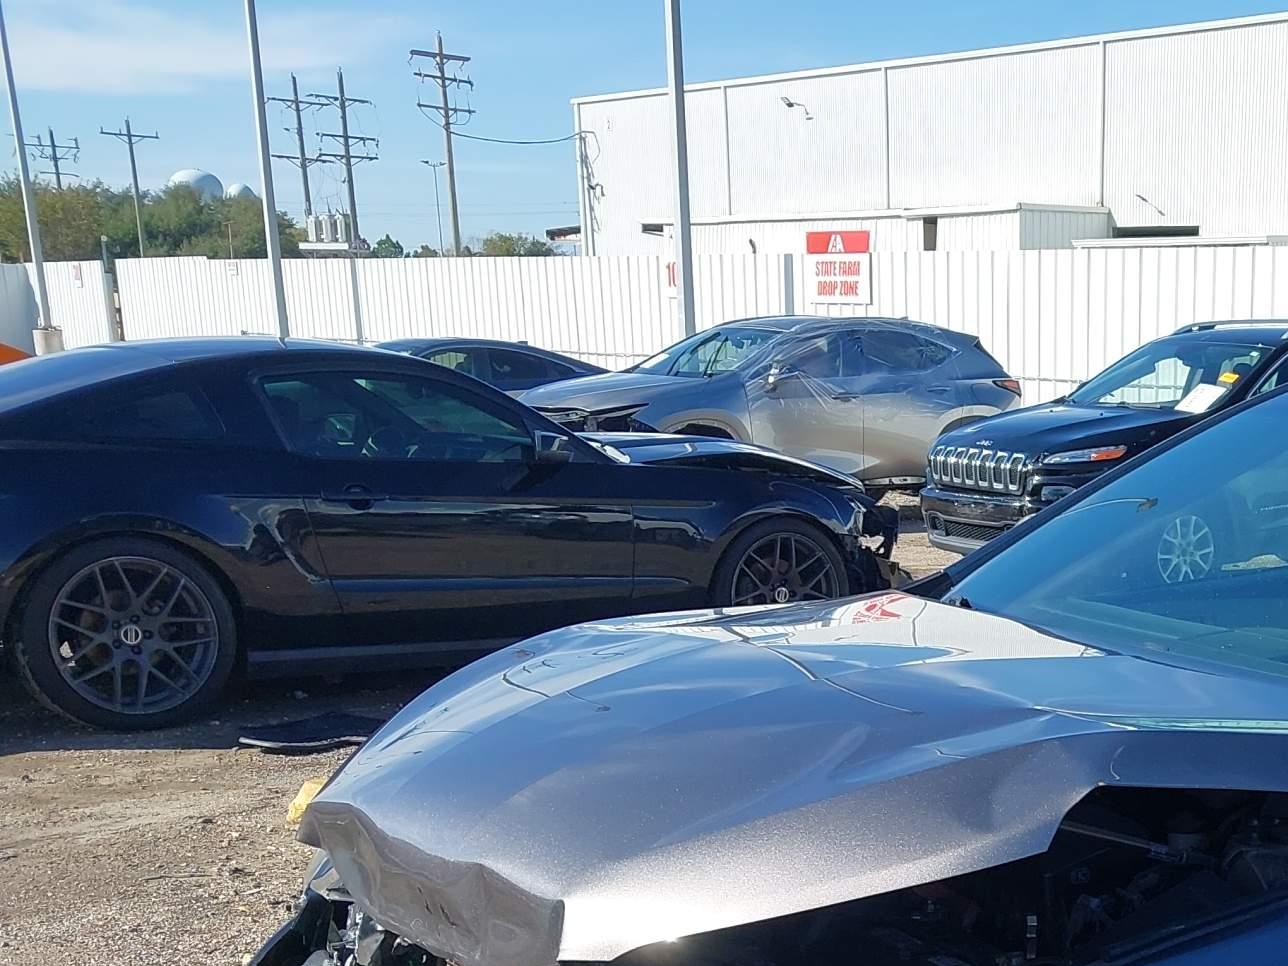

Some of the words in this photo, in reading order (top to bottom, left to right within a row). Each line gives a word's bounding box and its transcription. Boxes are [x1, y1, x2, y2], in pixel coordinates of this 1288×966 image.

[815, 260, 837, 277] STATE
[838, 260, 861, 277] FARM
[817, 280, 838, 297] DROP
[839, 280, 859, 297] ZONE
